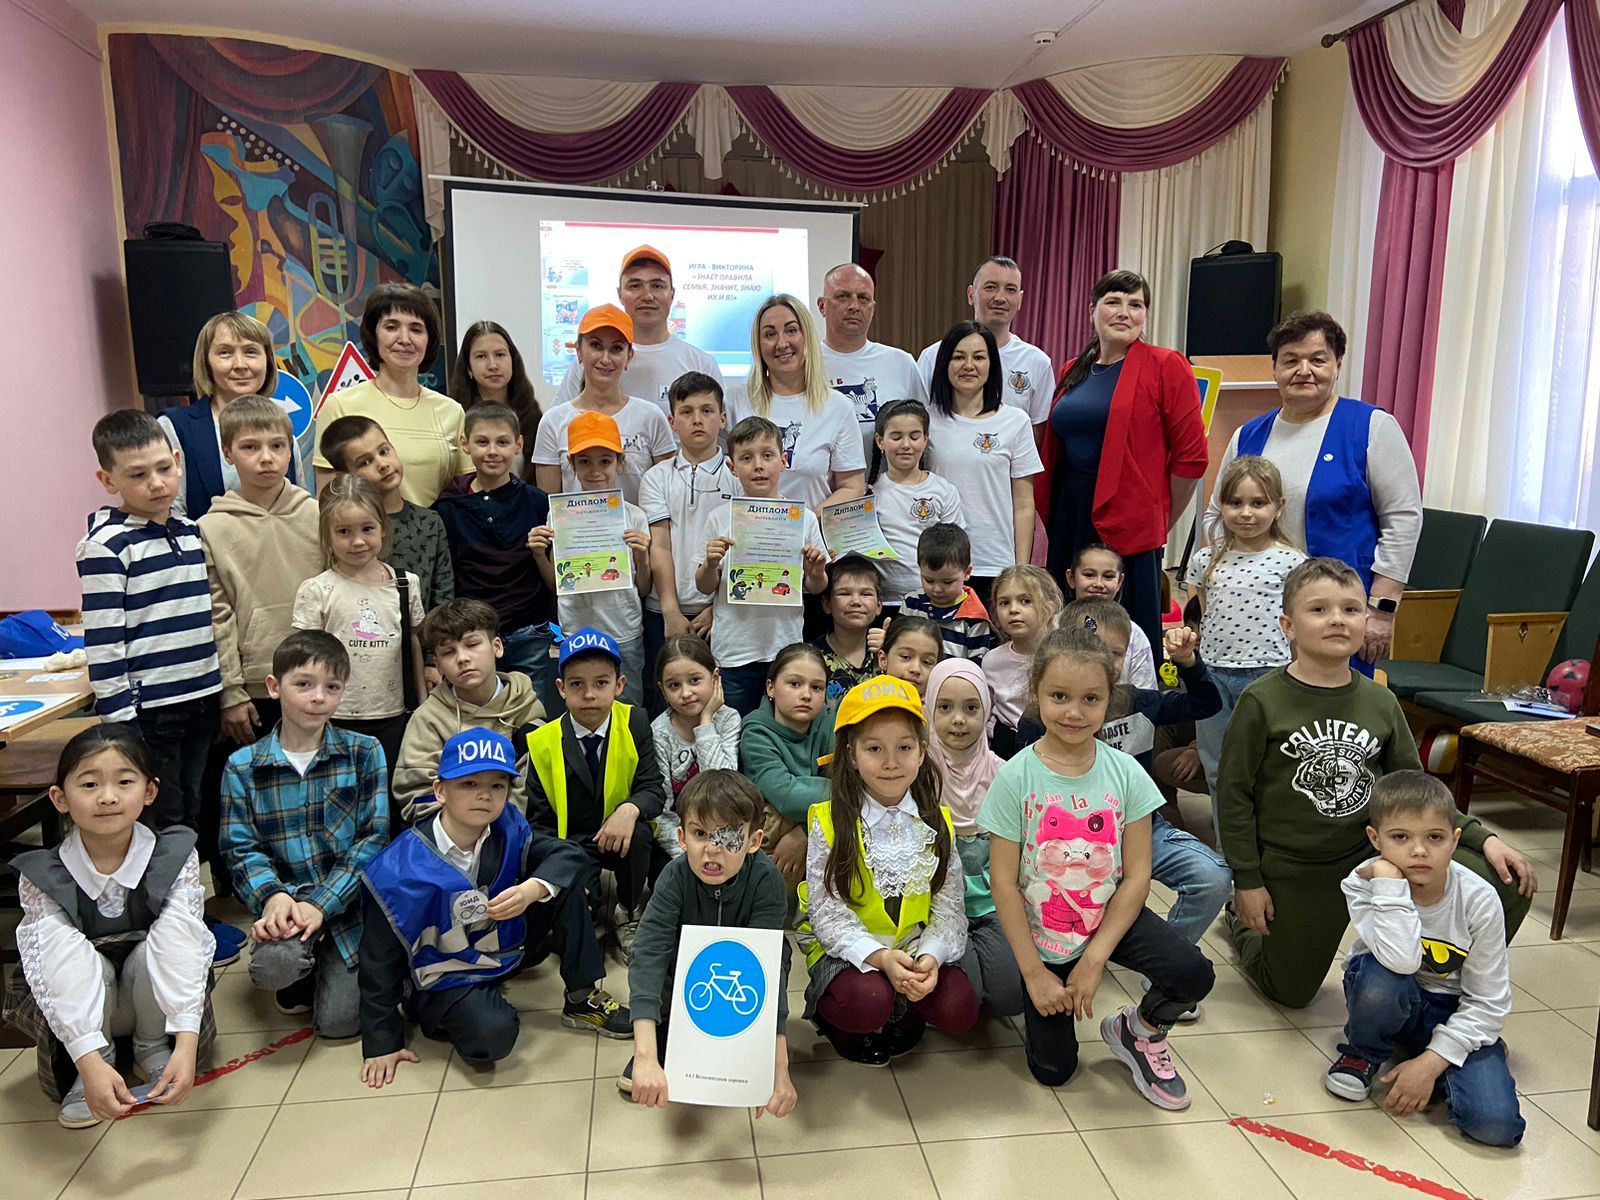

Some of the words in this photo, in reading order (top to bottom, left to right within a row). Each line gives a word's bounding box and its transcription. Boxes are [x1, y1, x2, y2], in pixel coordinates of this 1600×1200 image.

[369, 640, 389, 648] KITTY
[569, 633, 610, 652] ЮИД
[862, 682, 910, 702] ЮИД
[457, 739, 507, 764] ЮИД
[1044, 793, 1063, 803] fan
[1070, 795, 1088, 810] la
[1104, 792, 1120, 807] fan
[460, 895, 480, 907] ЮИД
